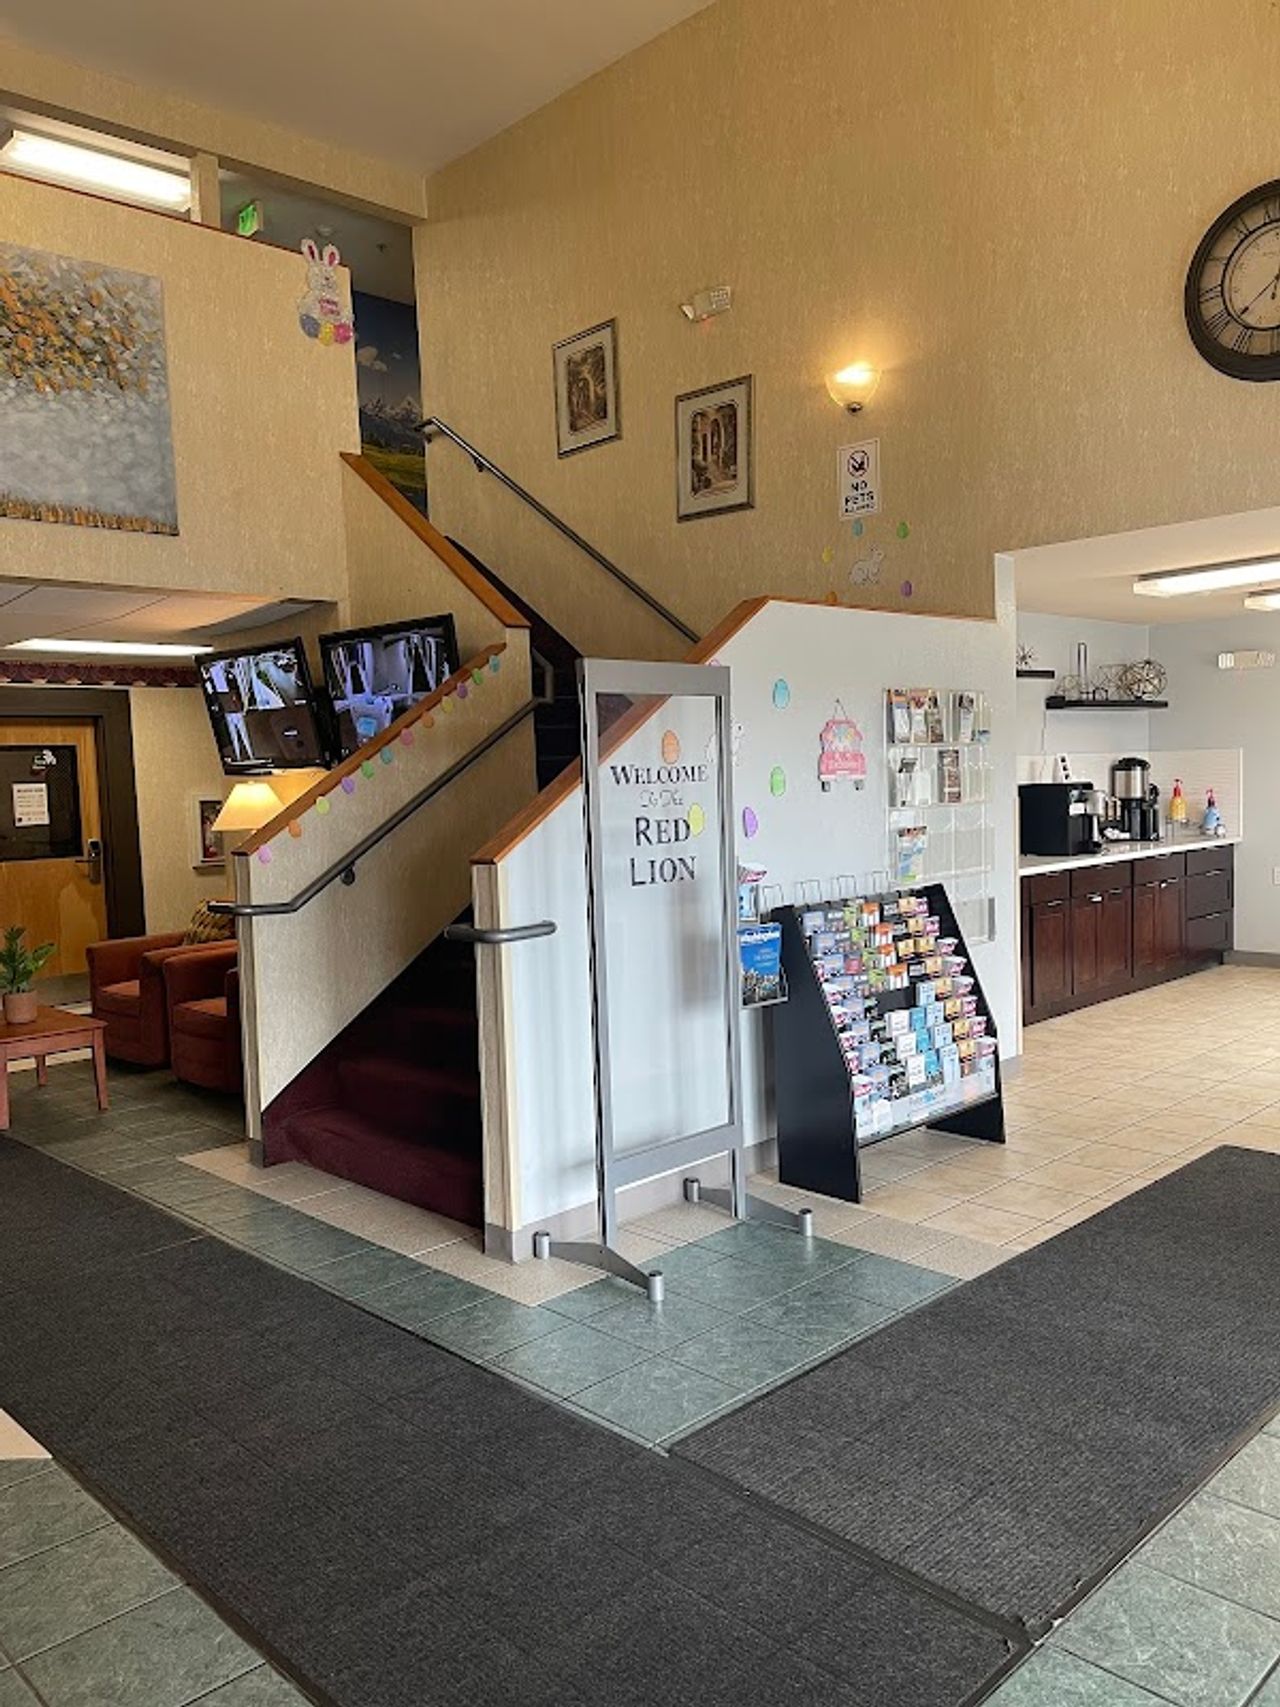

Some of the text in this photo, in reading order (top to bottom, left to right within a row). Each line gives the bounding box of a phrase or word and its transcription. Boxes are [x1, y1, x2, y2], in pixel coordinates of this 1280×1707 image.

[610, 764, 709, 785] WELCOME
[635, 816, 691, 846] RED
[630, 855, 697, 886] LION
